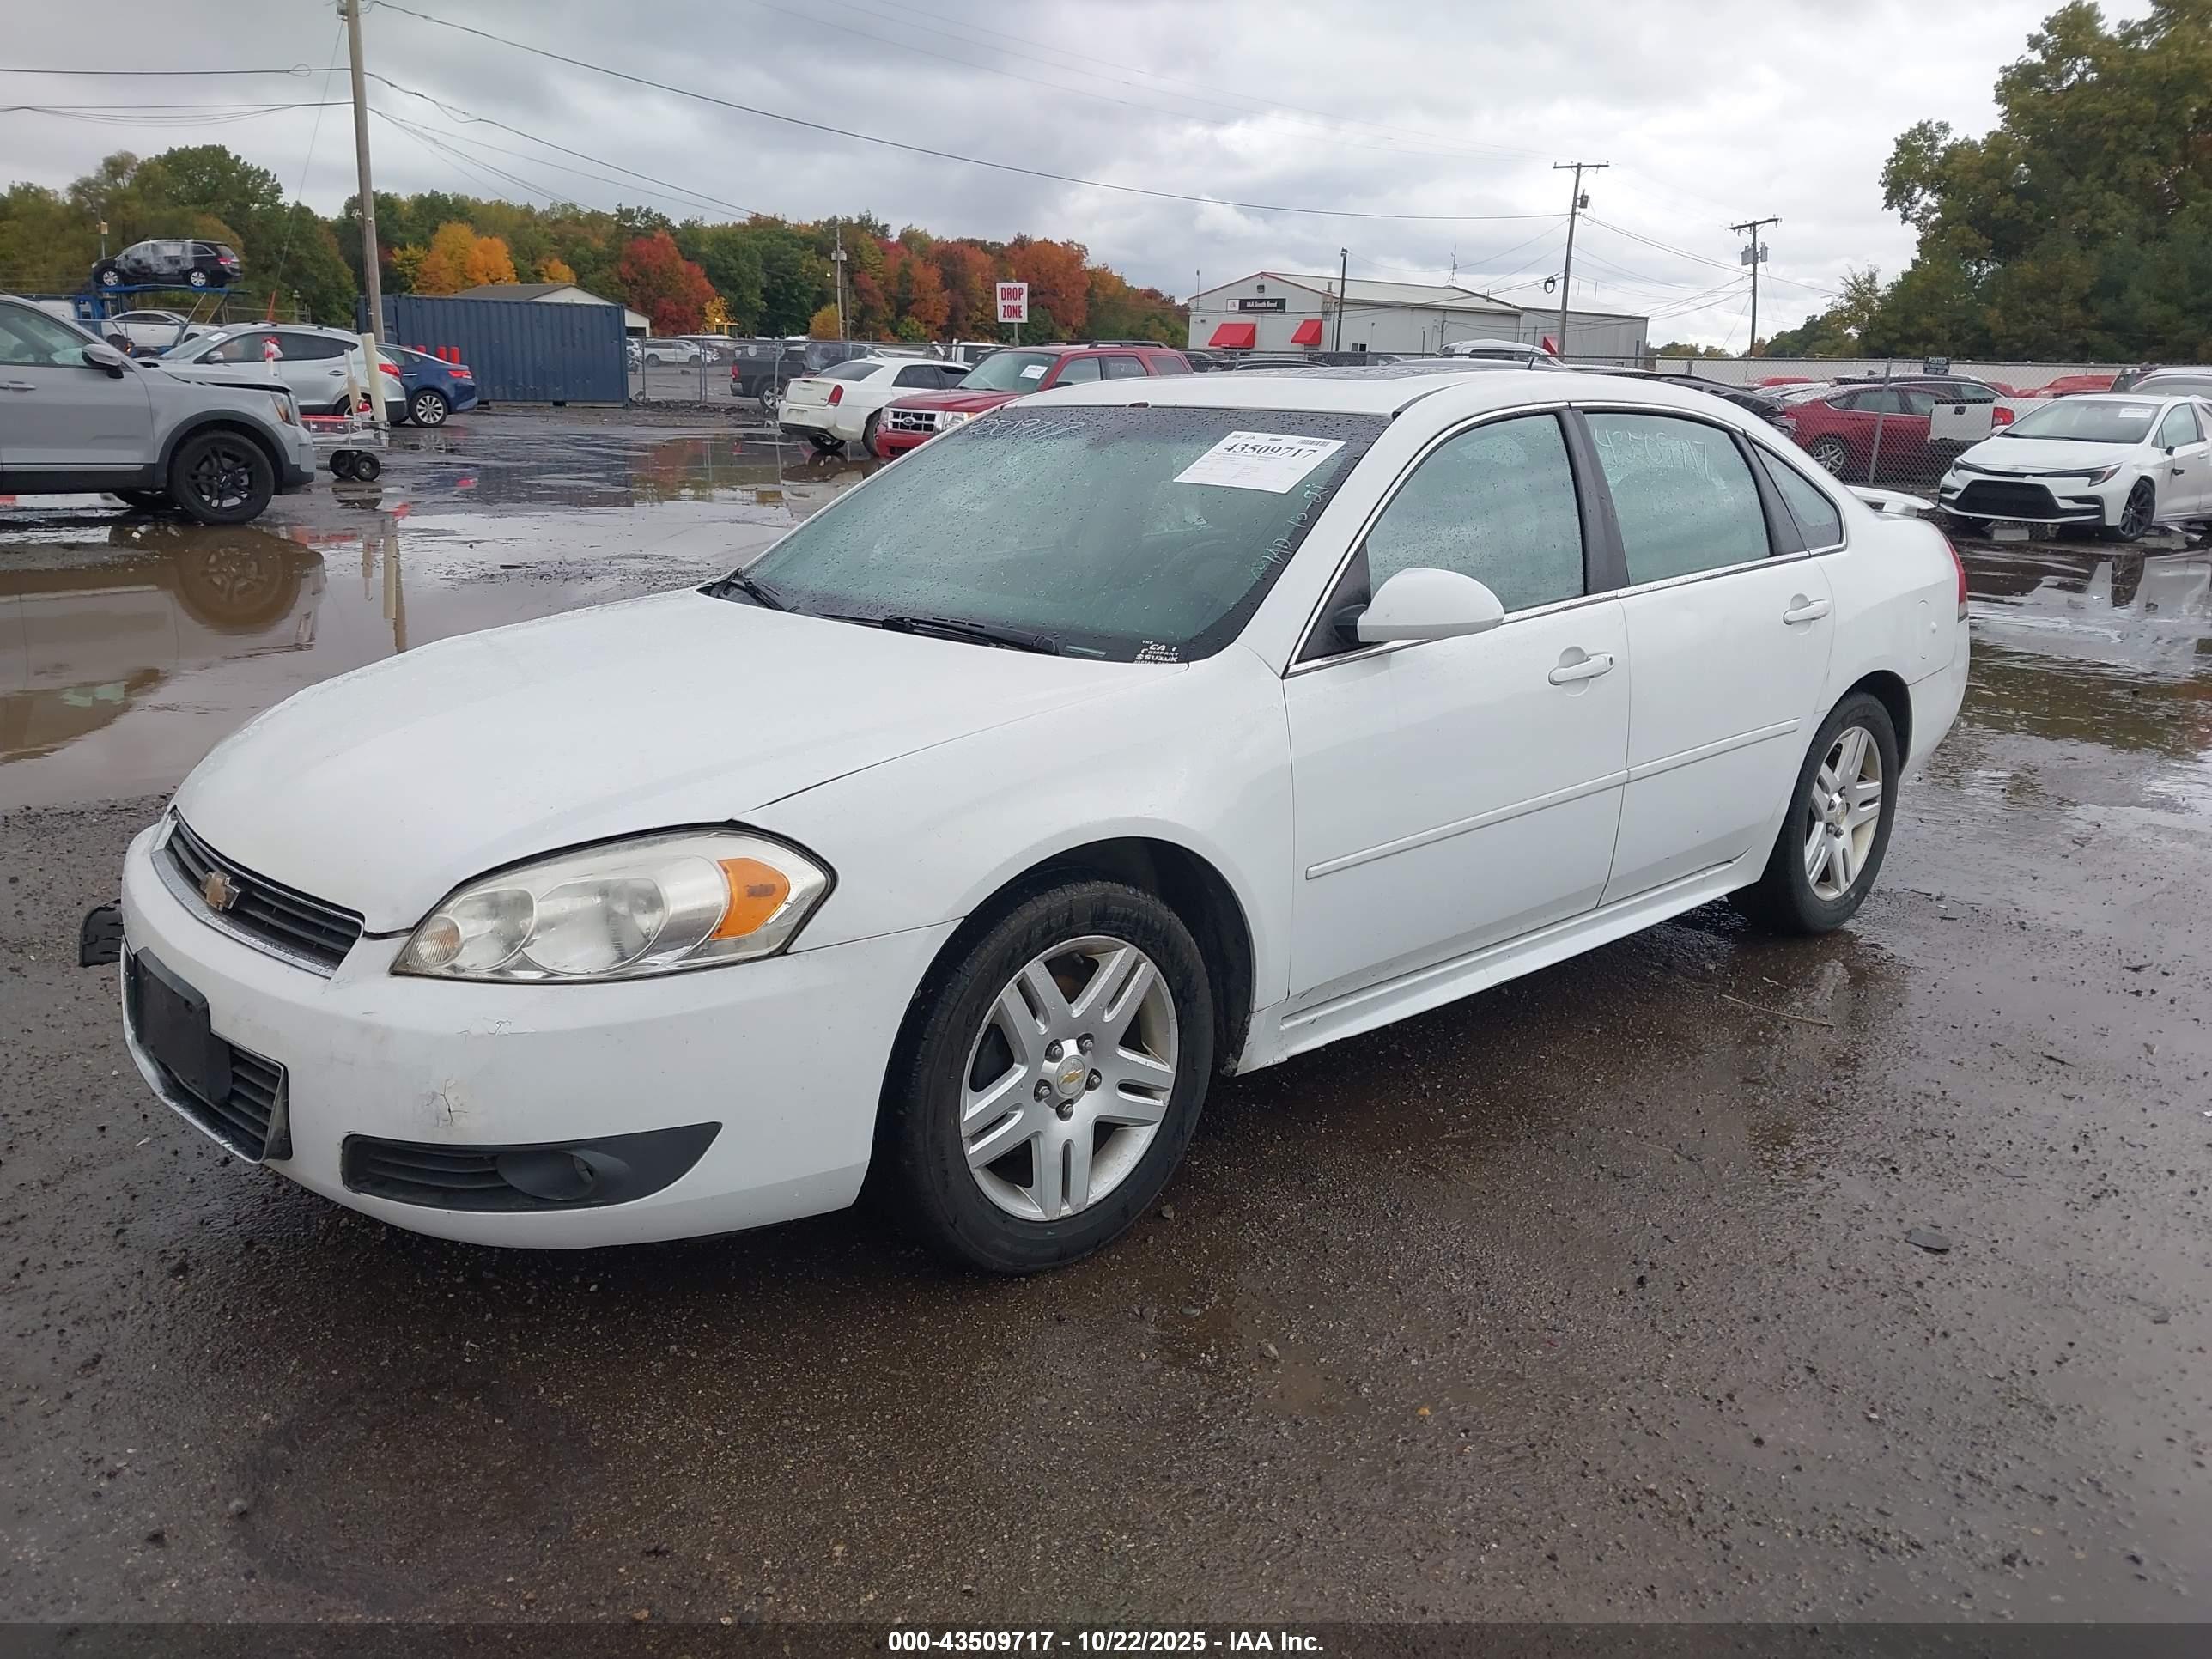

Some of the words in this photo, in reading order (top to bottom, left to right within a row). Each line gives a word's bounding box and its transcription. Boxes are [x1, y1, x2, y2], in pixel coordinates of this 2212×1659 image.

[1000, 287, 1024, 301] DROP
[1002, 305, 1023, 319] ZONE
[1224, 442, 1319, 459] 43509717
